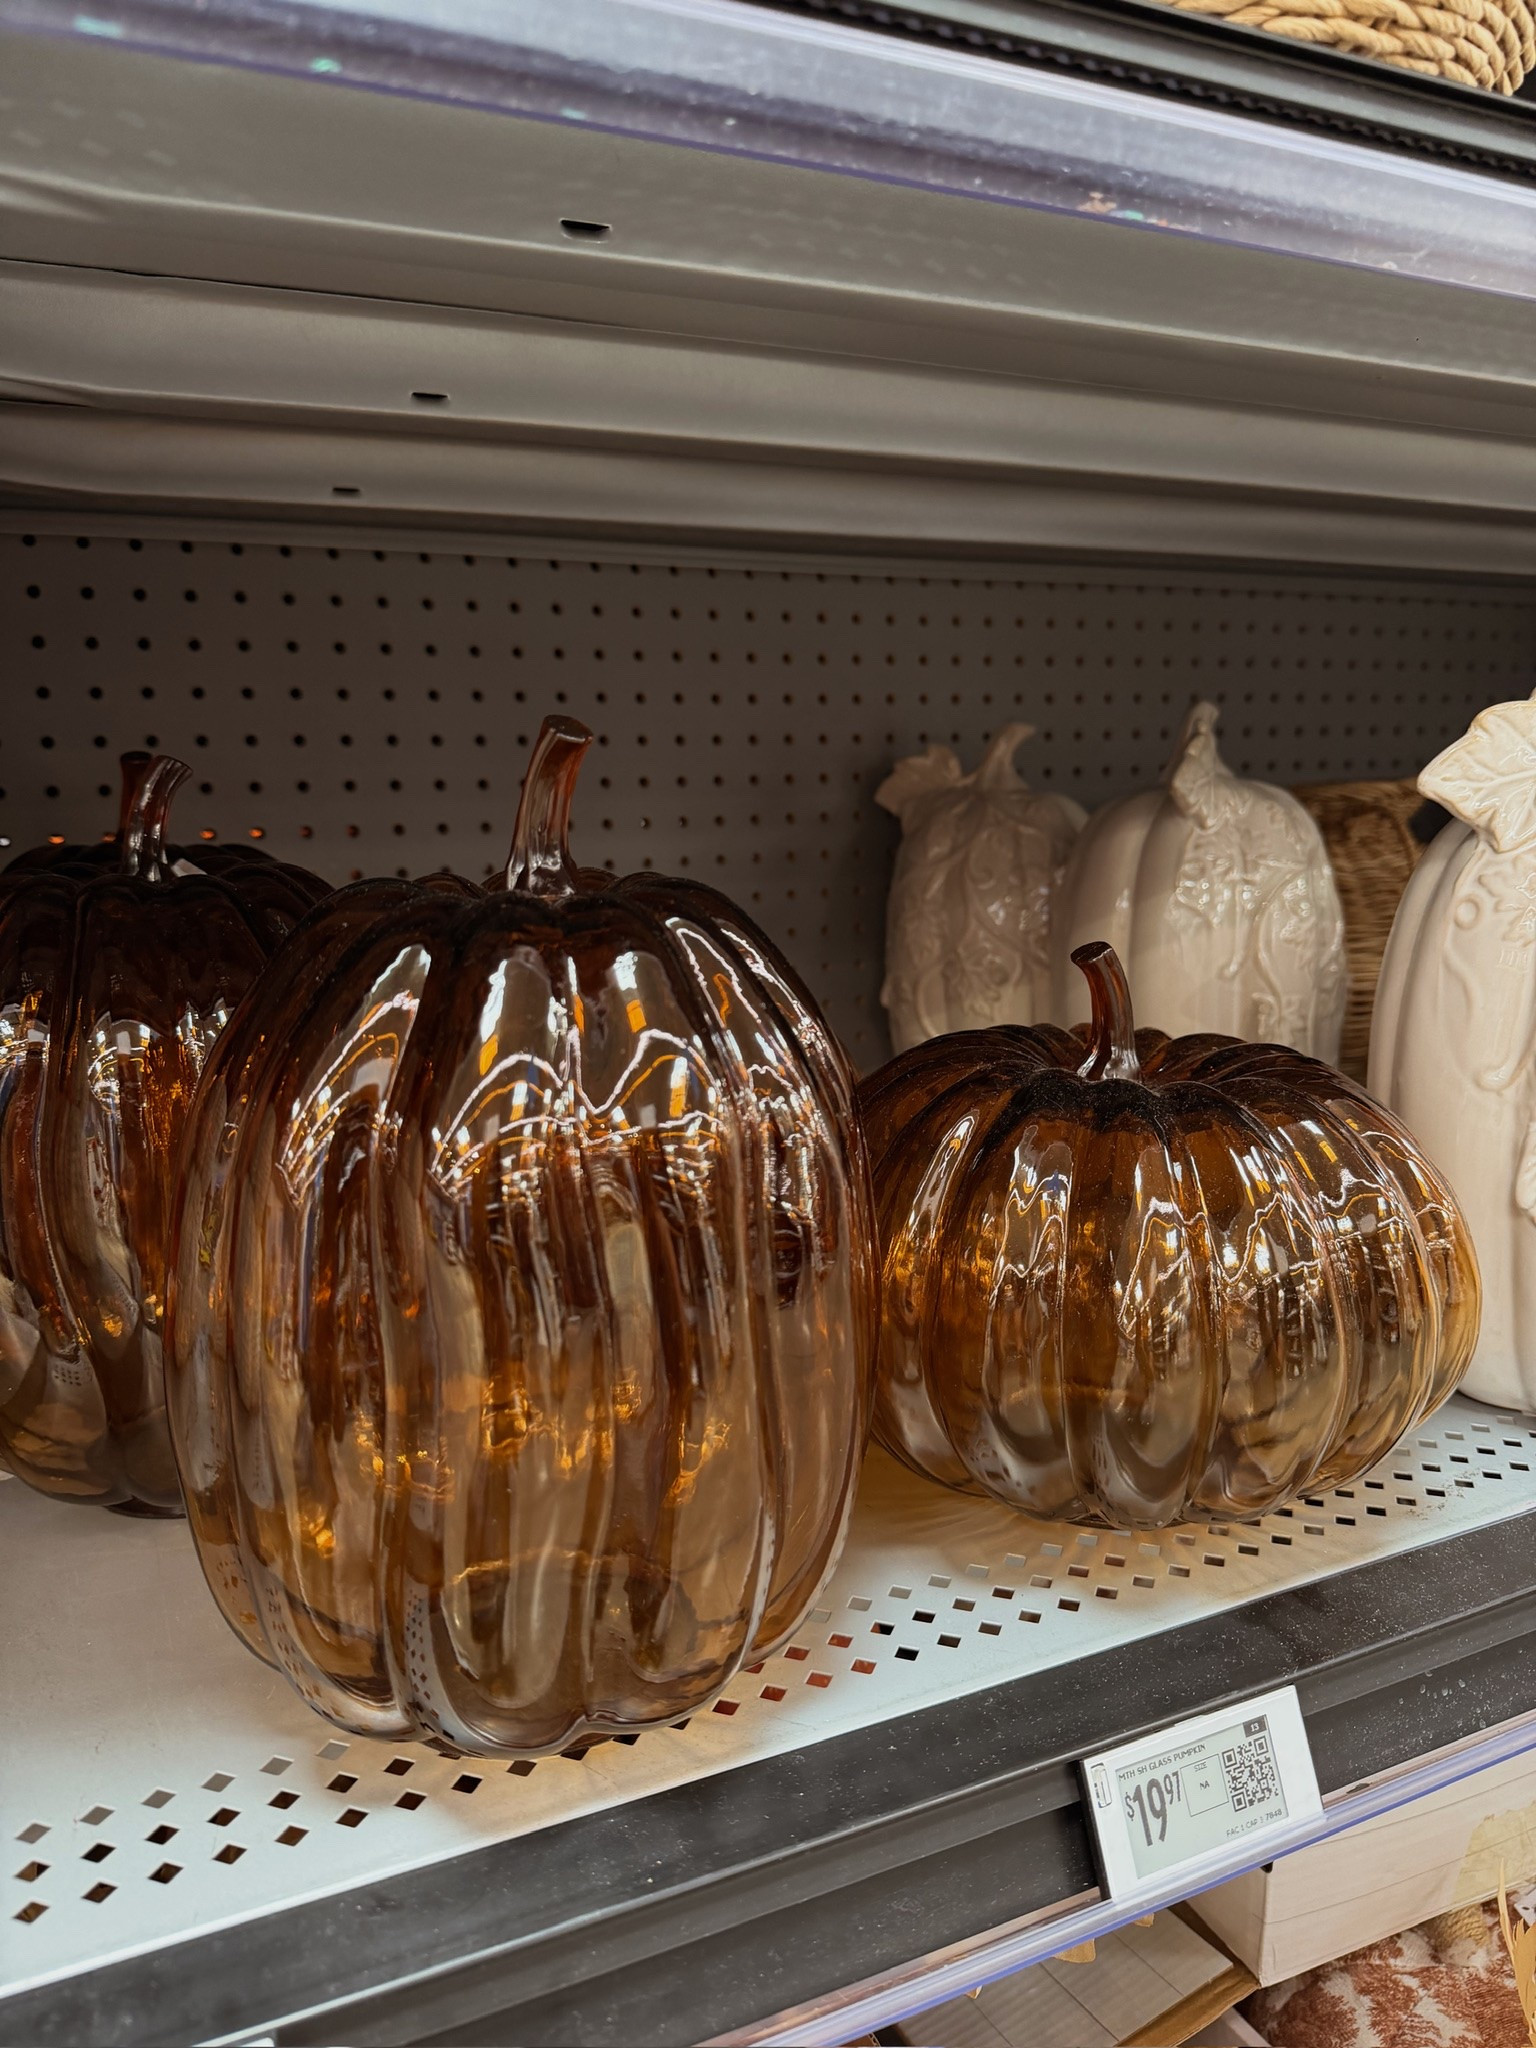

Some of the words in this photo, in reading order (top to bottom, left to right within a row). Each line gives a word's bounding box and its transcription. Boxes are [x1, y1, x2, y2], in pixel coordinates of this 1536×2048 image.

[1250, 1722, 1260, 1732] 13
[1118, 1769, 1136, 1782] MTH
[1137, 1765, 1148, 1776] SH
[1149, 1755, 1172, 1771] GLASS
[1173, 1743, 1206, 1762] PUMPKIN
[1193, 1761, 1208, 1772] SIZE
[1199, 1780, 1210, 1790] NA
